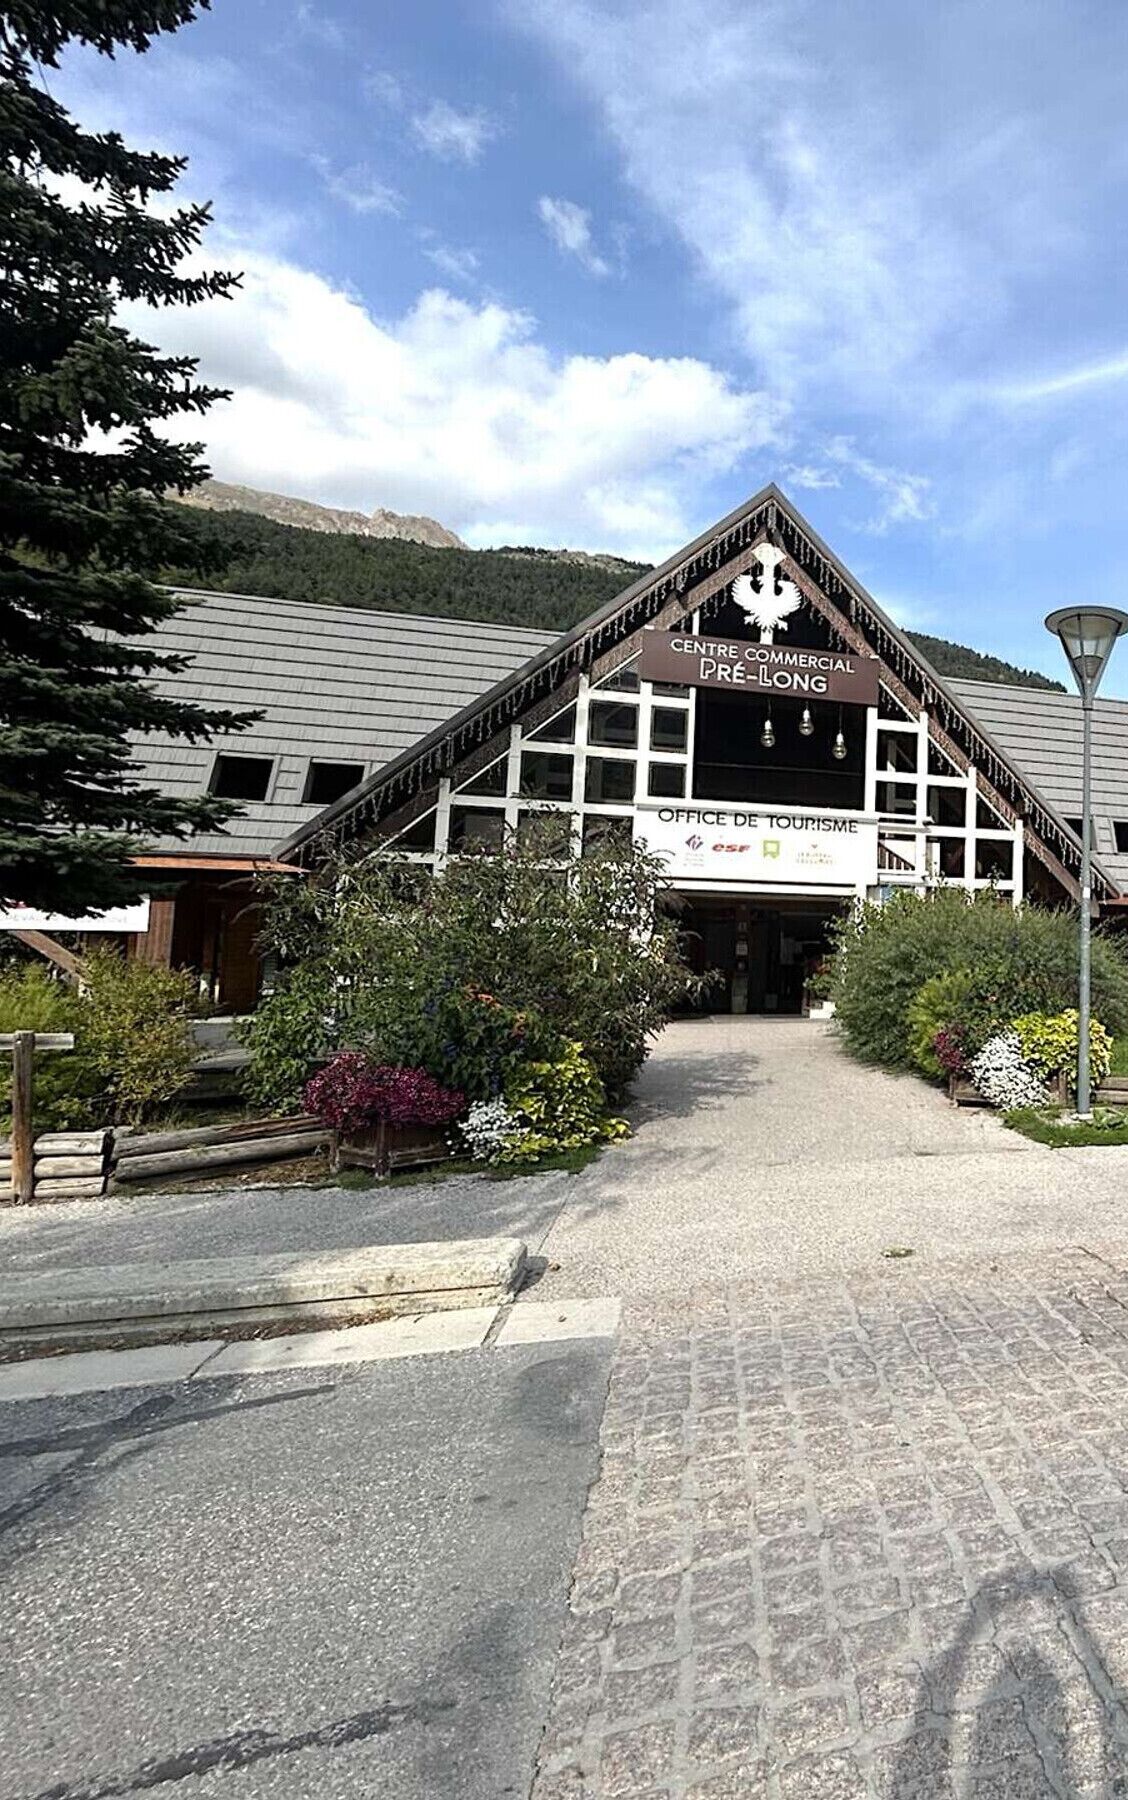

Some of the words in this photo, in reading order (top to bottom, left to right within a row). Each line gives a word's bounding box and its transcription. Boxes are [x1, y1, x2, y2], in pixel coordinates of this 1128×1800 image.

[670, 638, 739, 659] CENTRE
[744, 647, 856, 674] COMMERCIAL
[699, 657, 828, 694] PRÉ-LONG
[658, 808, 727, 826] OFFICE
[734, 812, 759, 828] DE
[766, 813, 859, 834] TOURISME
